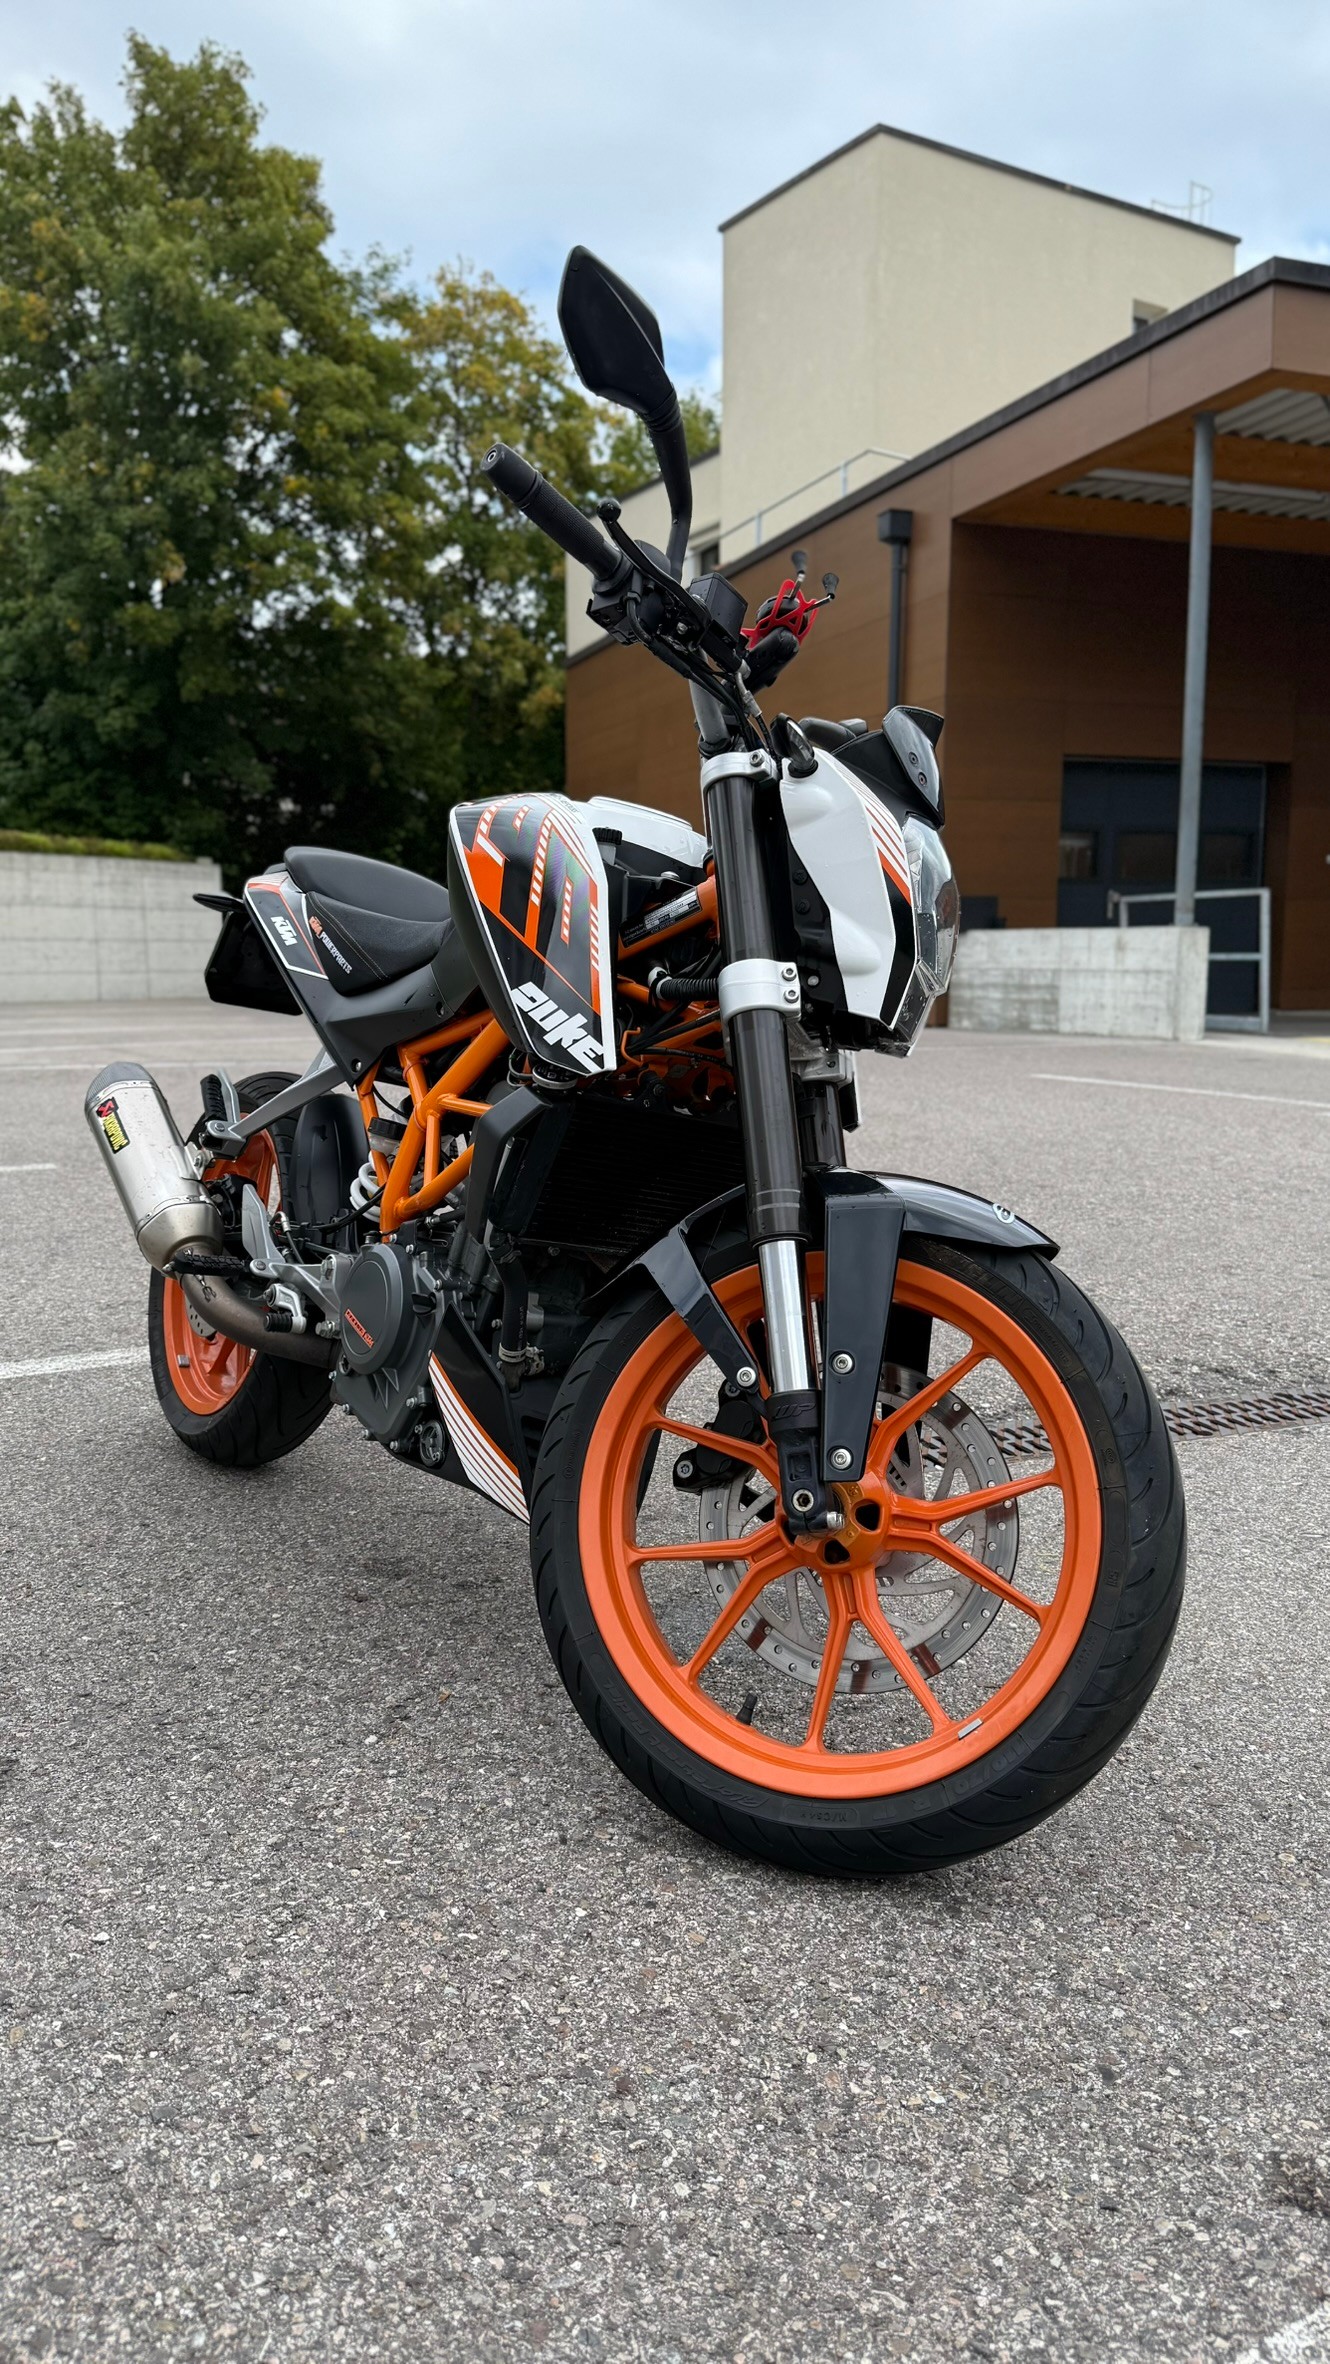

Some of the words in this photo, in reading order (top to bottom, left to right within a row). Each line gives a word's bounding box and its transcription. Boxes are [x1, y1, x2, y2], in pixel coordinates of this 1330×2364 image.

[270, 916, 298, 946] KTM
[320, 931, 352, 974] POWERPARTS
[510, 981, 604, 1073] DUKE
